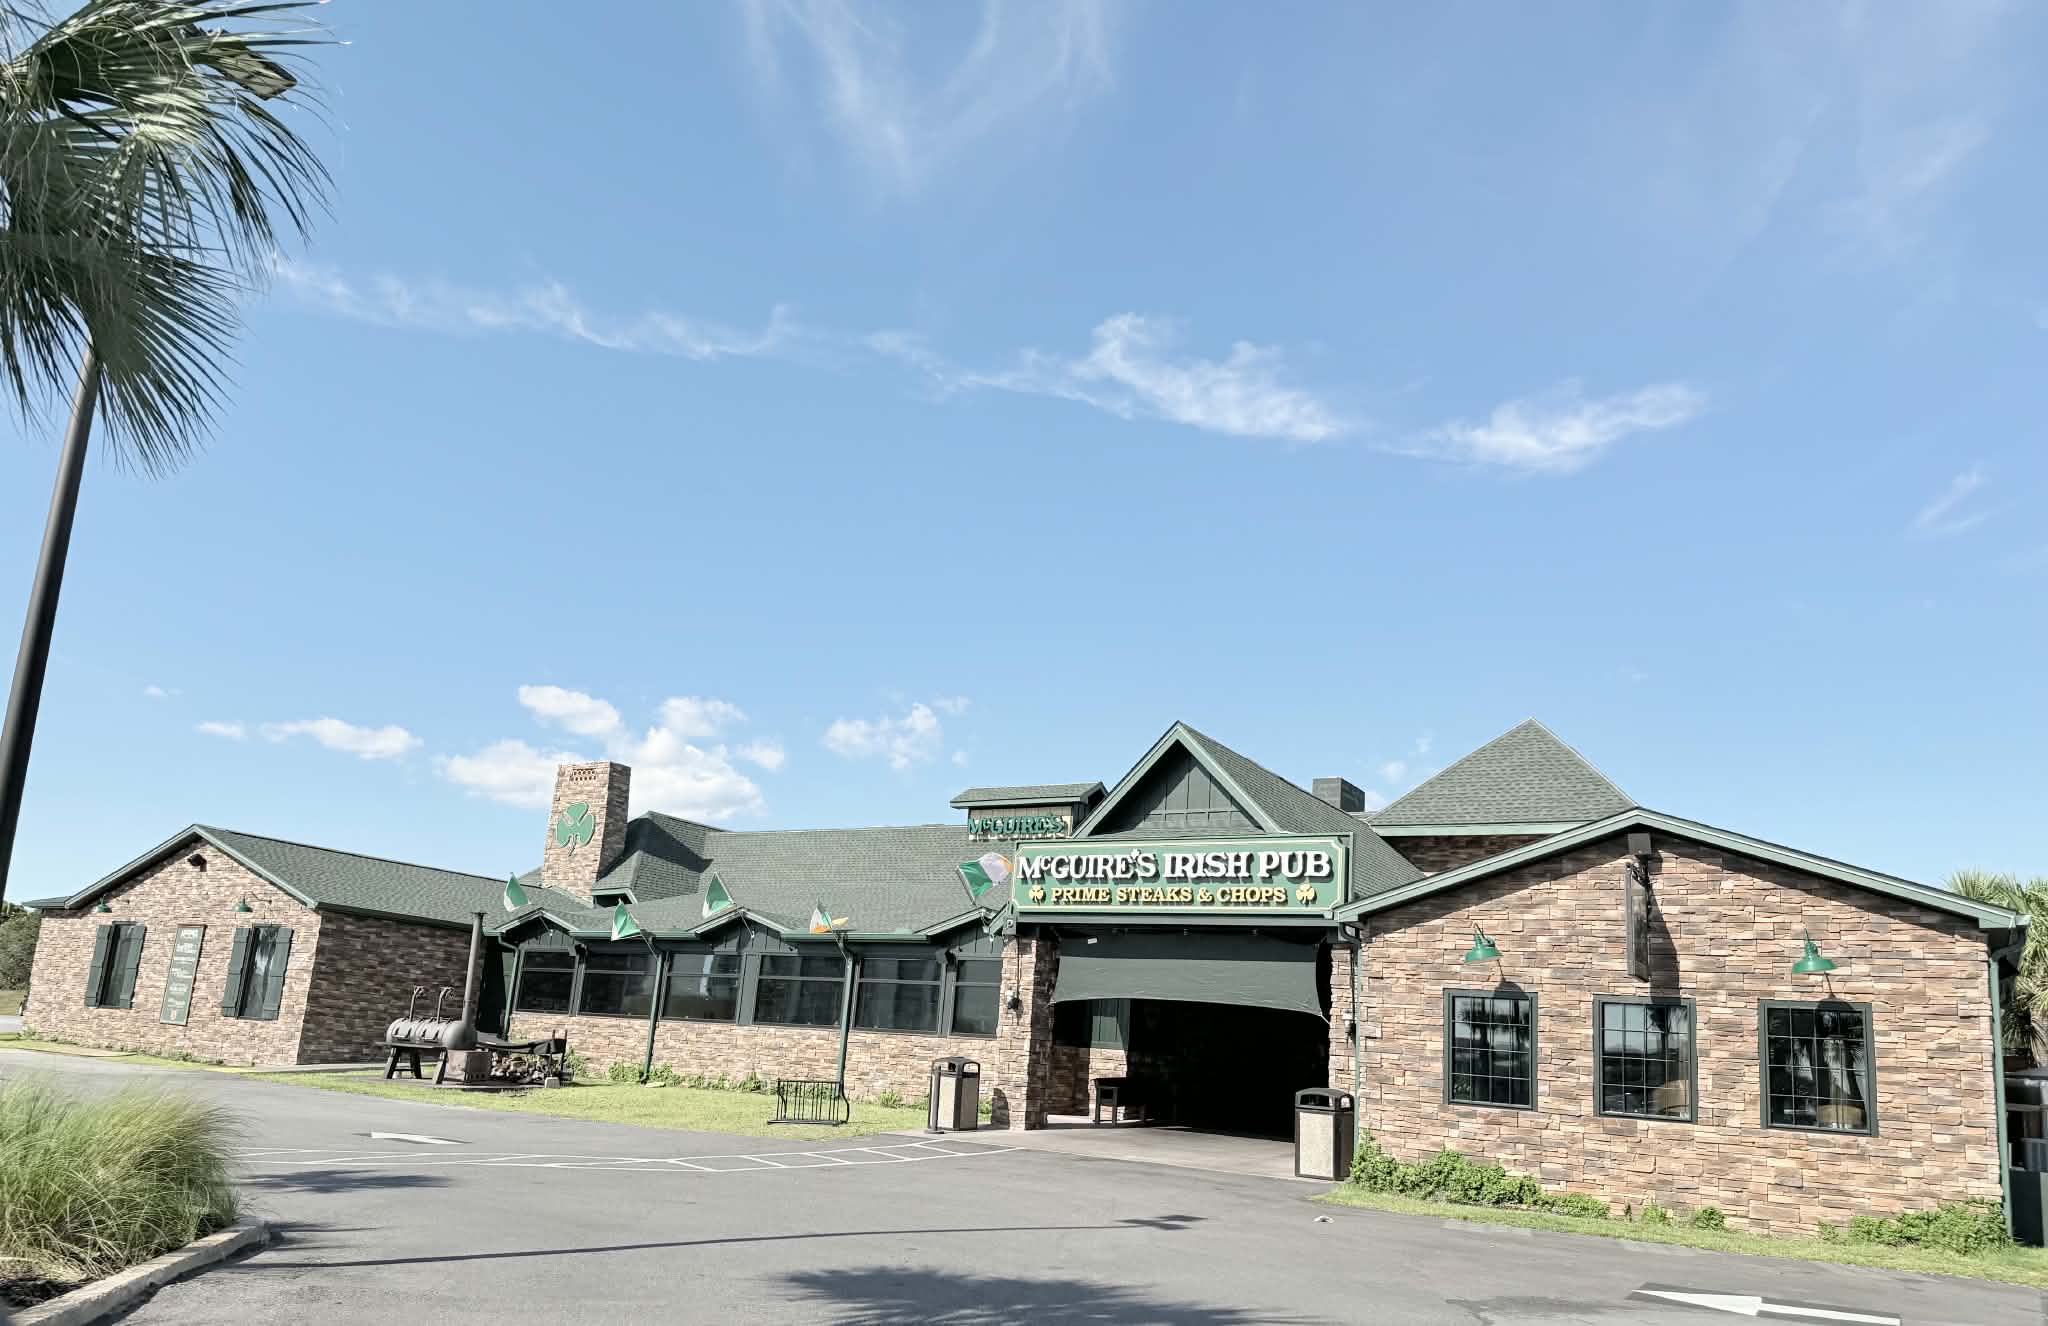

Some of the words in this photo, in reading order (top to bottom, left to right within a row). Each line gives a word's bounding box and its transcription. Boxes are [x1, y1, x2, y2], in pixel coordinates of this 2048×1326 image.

[1163, 852, 1250, 878] IRISH
[1257, 851, 1330, 877] PUB
[1051, 887, 1111, 902] PRIME
[1116, 887, 1192, 902] STEAKS
[1198, 887, 1213, 902] &
[1216, 887, 1286, 902] CHOPS
